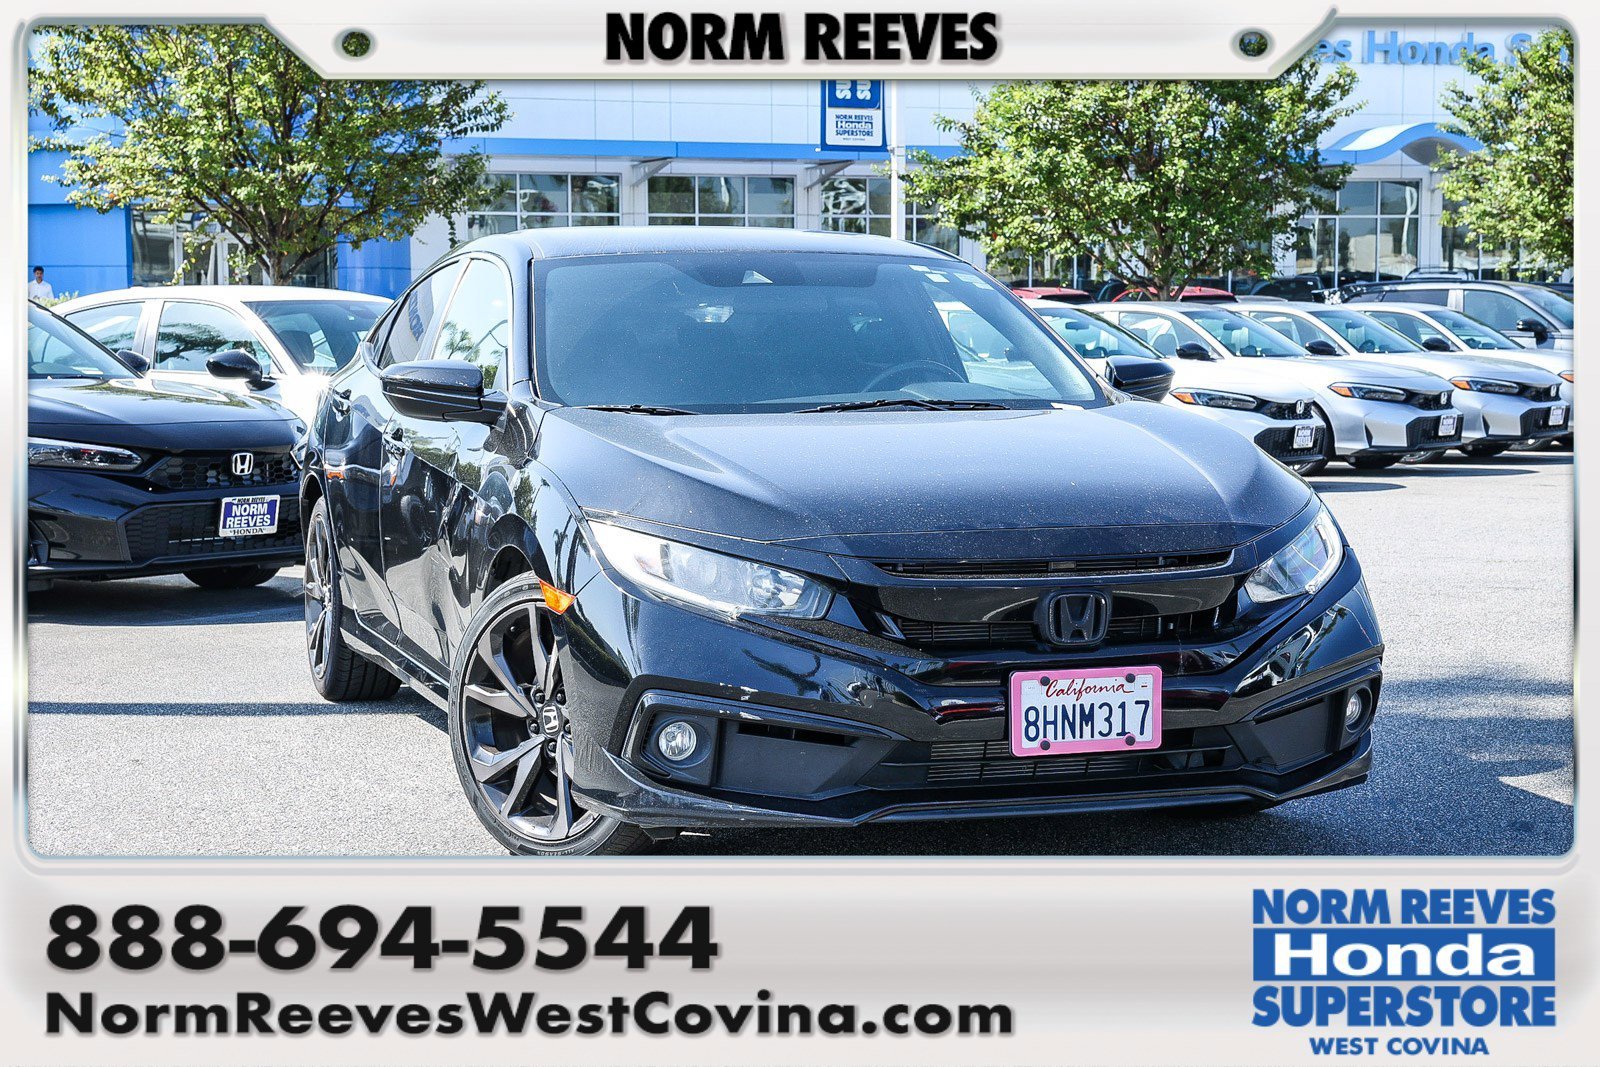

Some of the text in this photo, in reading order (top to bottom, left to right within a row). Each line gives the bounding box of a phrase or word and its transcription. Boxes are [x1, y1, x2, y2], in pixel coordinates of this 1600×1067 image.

[1363, 30, 1500, 64] Honda
[837, 121, 872, 129] Honda
[232, 503, 268, 516] NORM
[226, 515, 271, 528] REEVES
[1045, 677, 1135, 702] California
[1024, 700, 1150, 742] 8HNM317
